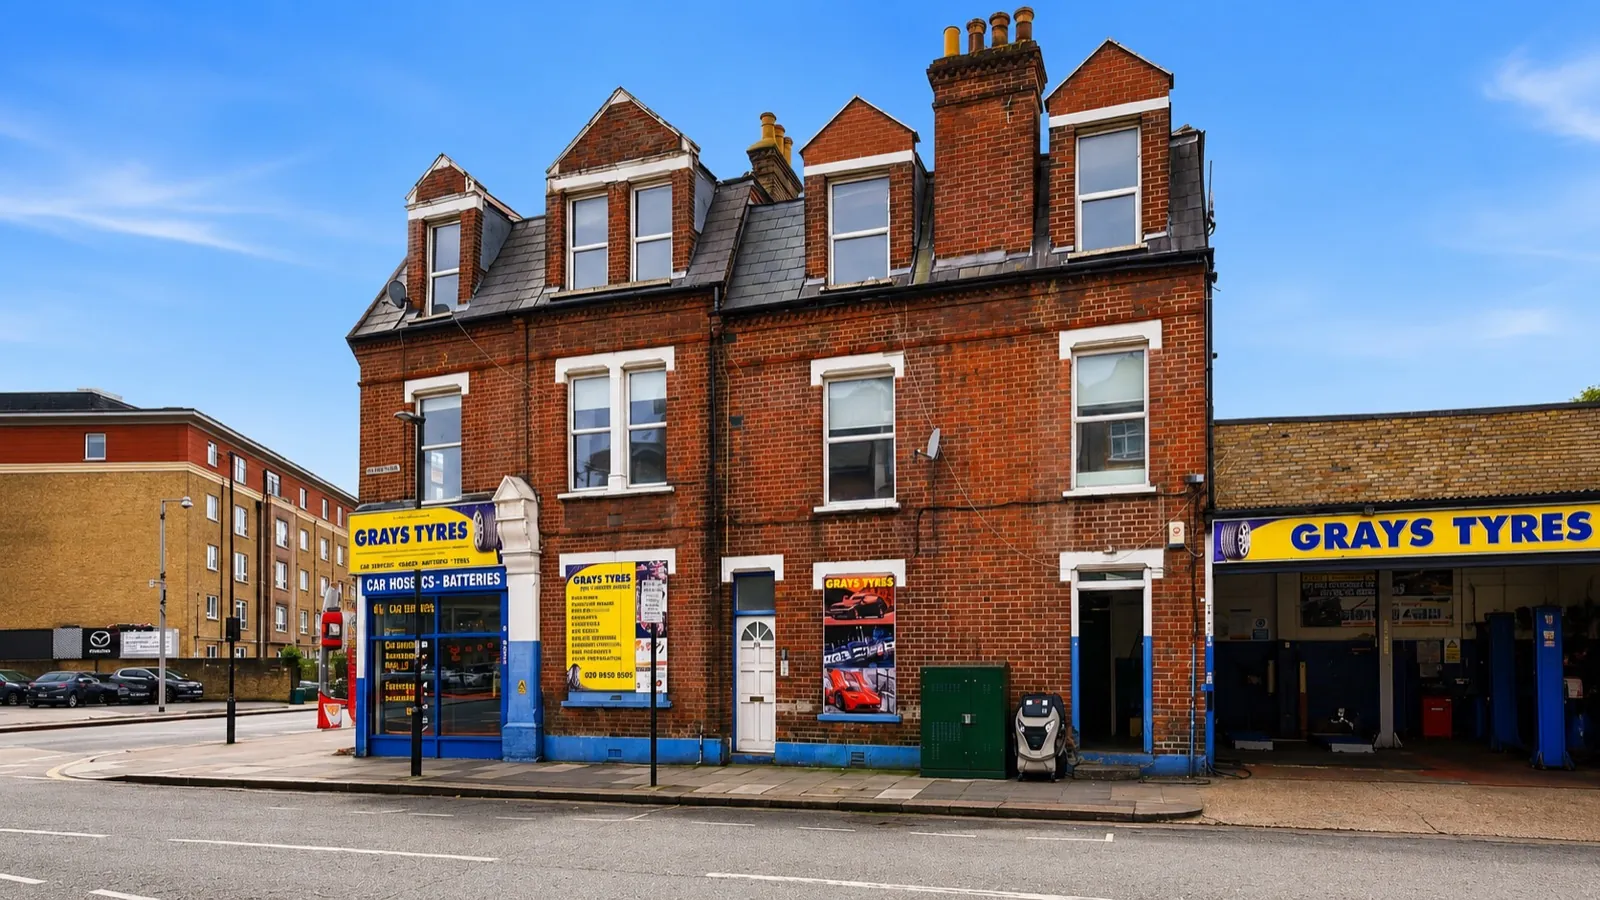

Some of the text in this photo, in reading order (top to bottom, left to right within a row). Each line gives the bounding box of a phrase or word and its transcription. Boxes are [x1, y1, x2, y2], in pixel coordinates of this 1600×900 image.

[354, 521, 468, 547] GRAYS TYRES
[1290, 511, 1593, 551] GRAYS TYRES
[366, 578, 386, 592] CAR
[442, 572, 501, 588] BATTERIES
[573, 573, 631, 585] GRAYS TYRES
[825, 577, 894, 589] GRAYS TYRES
[584, 671, 597, 679] 020
